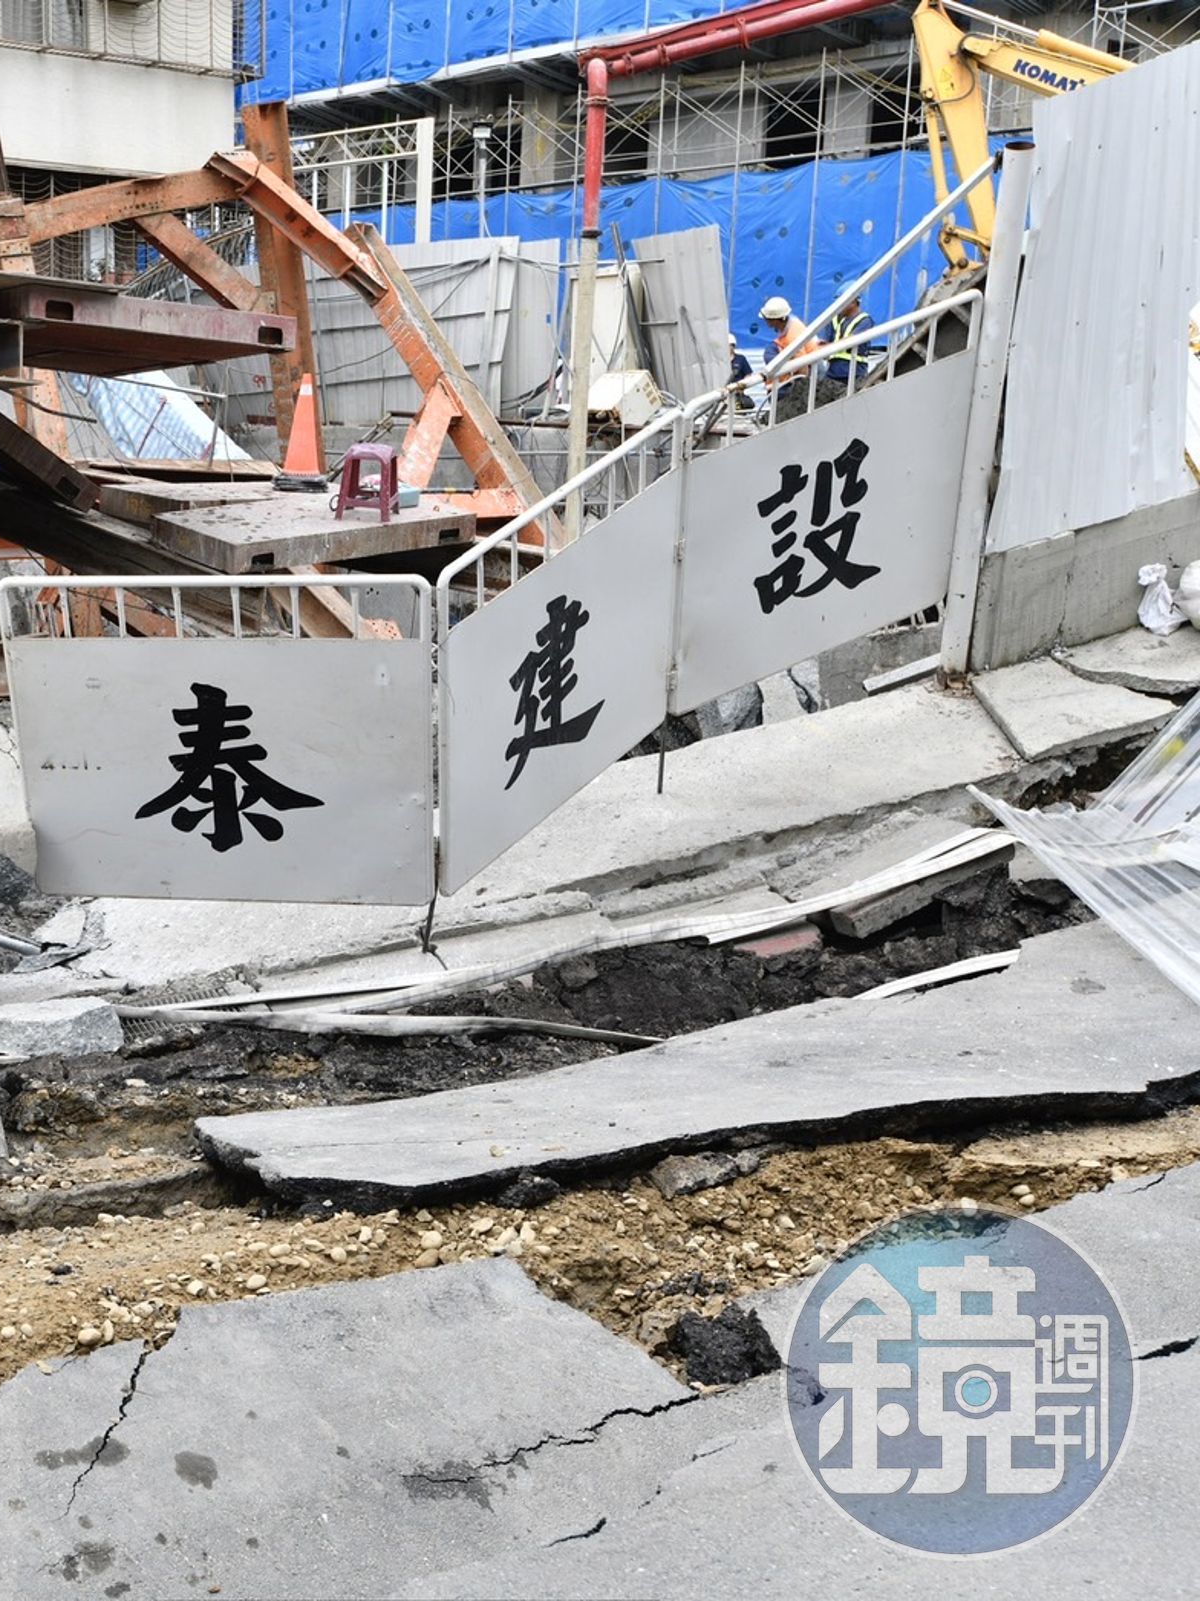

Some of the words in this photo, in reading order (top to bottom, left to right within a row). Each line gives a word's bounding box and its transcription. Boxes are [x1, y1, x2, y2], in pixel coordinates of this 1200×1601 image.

[1013, 58, 1086, 91] KOMAT
[134, 682, 326, 853] 泰
[503, 594, 606, 791] 建
[753, 437, 882, 615] 設
